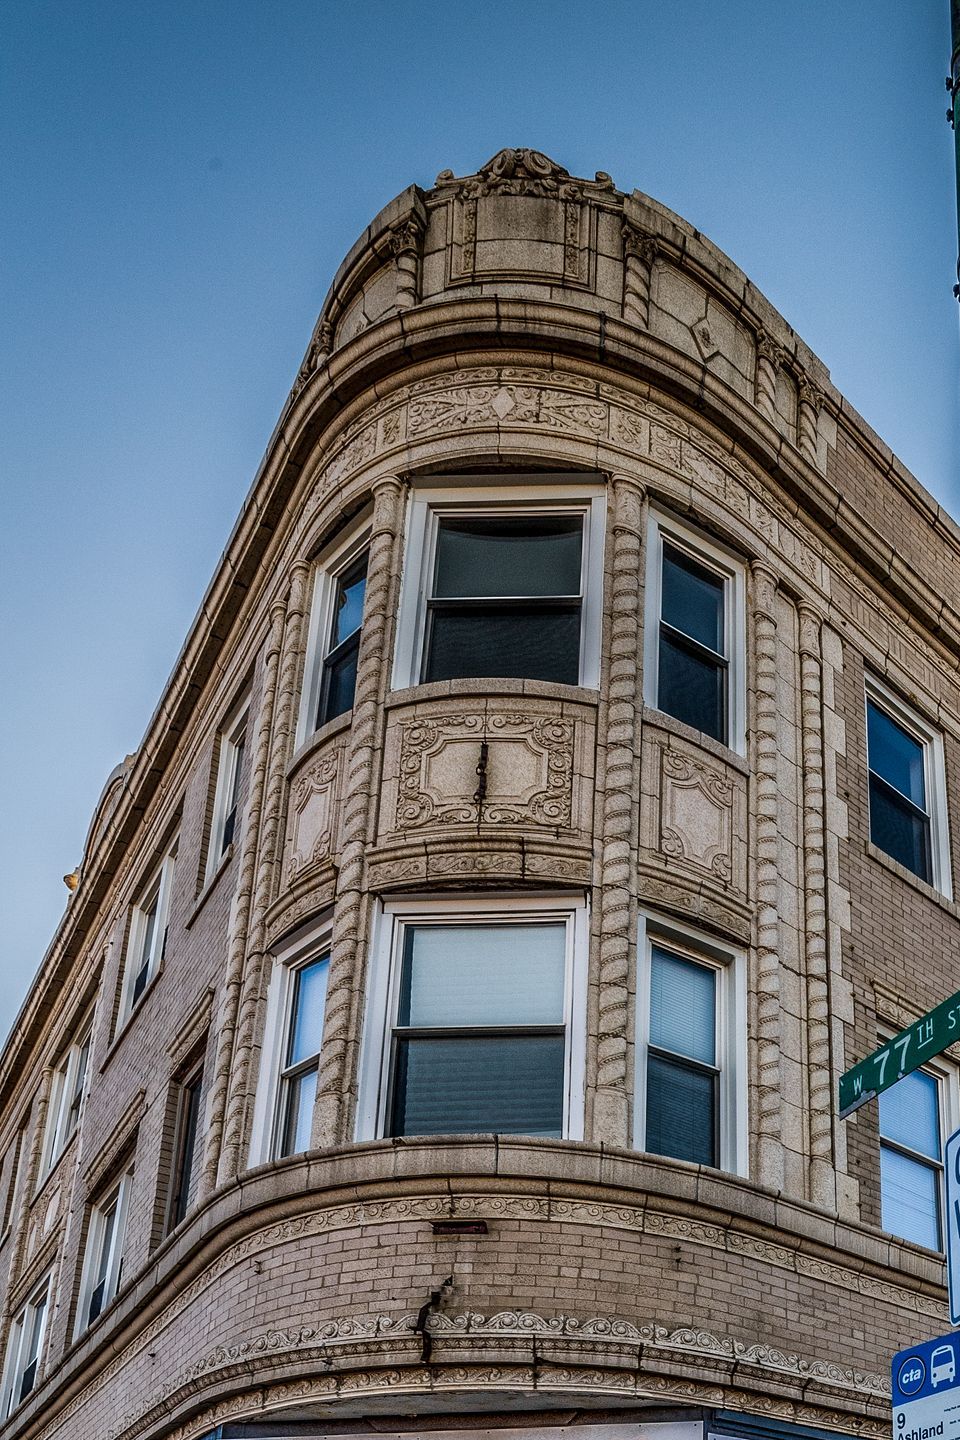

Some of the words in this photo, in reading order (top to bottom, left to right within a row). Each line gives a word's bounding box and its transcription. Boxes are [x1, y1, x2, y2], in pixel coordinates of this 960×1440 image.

[853, 1077, 864, 1097] W
[902, 1368, 922, 1384] cta
[896, 1412, 906, 1430] 9
